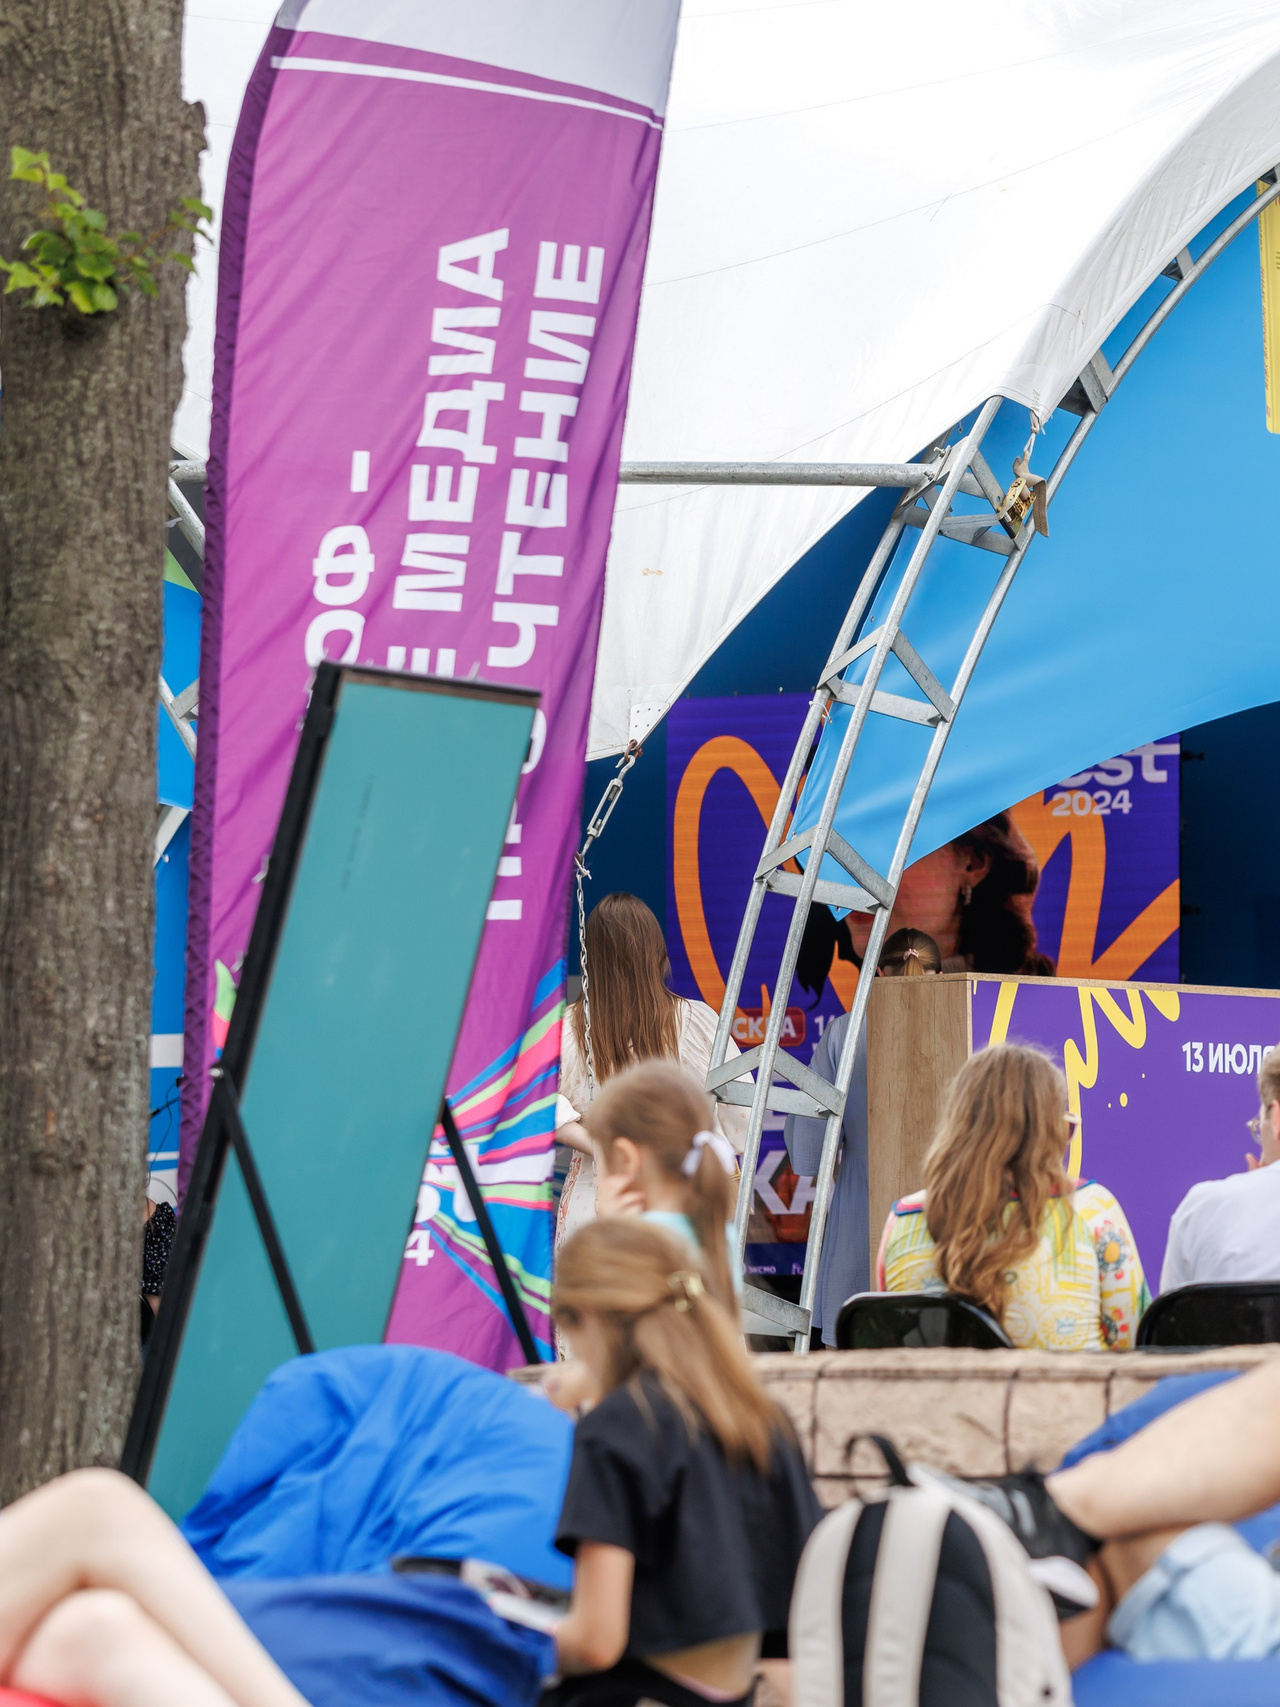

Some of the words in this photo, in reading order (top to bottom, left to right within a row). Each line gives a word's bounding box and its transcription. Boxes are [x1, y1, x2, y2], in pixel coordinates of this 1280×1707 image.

[392, 228, 509, 612] МЕДИА
[487, 241, 604, 668] ЧТЕНИЕ
[1051, 789, 1133, 817] 2024
[1182, 1041, 1204, 1073] 13
